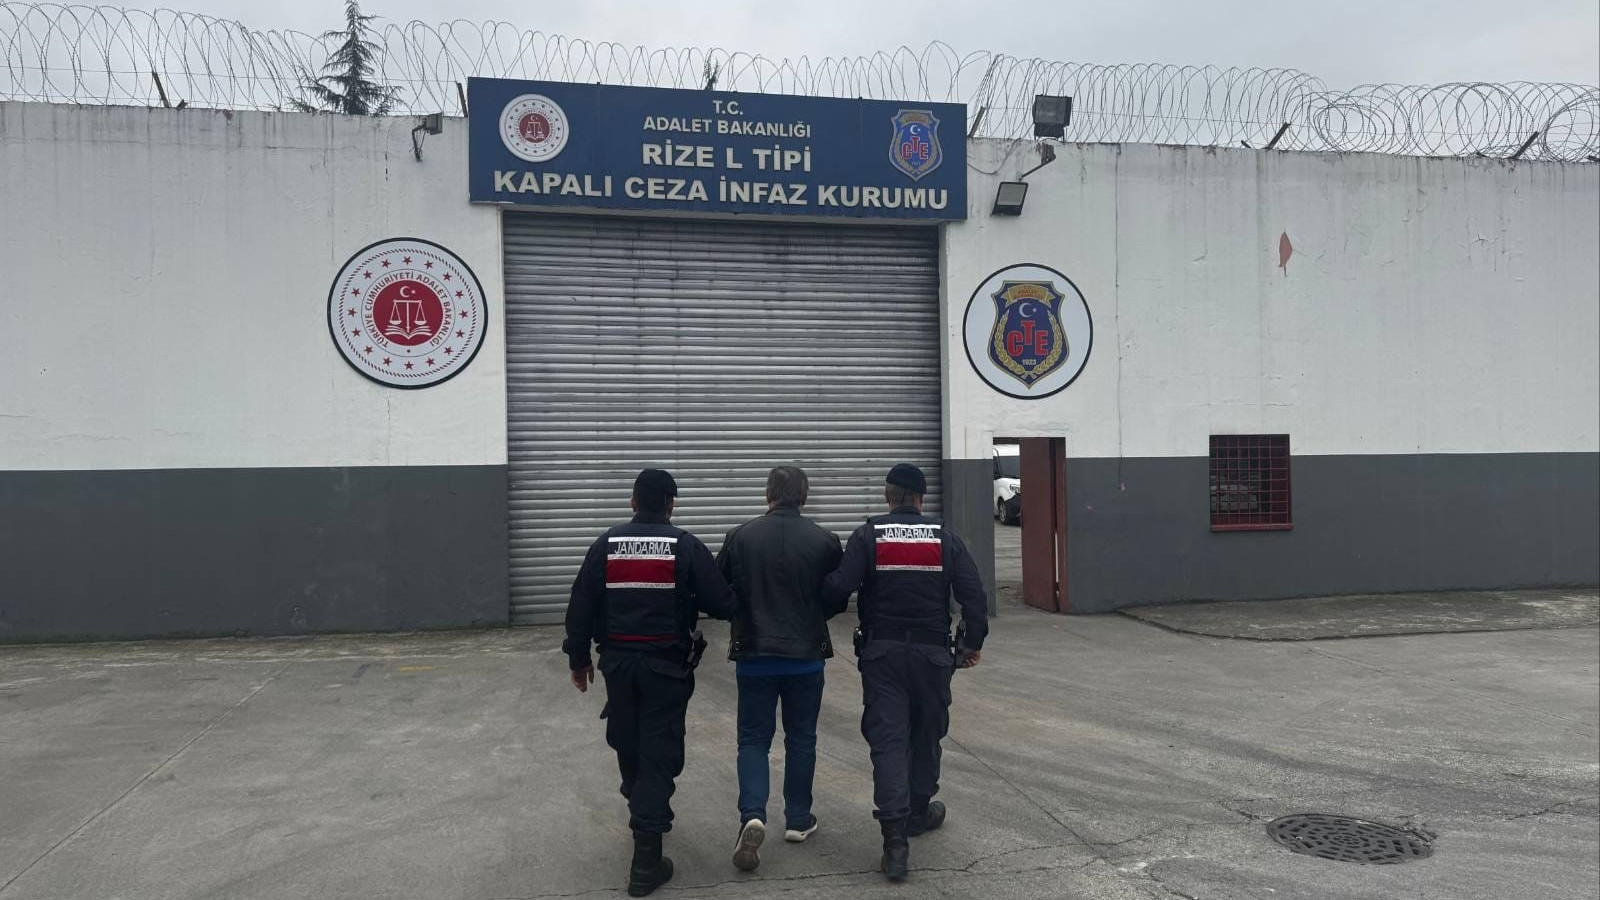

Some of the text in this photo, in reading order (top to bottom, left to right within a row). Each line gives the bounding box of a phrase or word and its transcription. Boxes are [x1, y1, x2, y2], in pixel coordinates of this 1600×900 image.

[712, 100, 743, 115] T.C.
[643, 116, 811, 138] ADALET BAKANLIĞI
[642, 139, 811, 172] RİZE L TİPİ
[494, 170, 948, 210] KAPALI CEZA İNFAZ KURUMU
[364, 272, 452, 348] TÜRKİYE CUMHURİYETİ ADALET BAKANLIĞI
[882, 527, 935, 539] JANDARMA
[614, 541, 672, 555] JANDARMA
